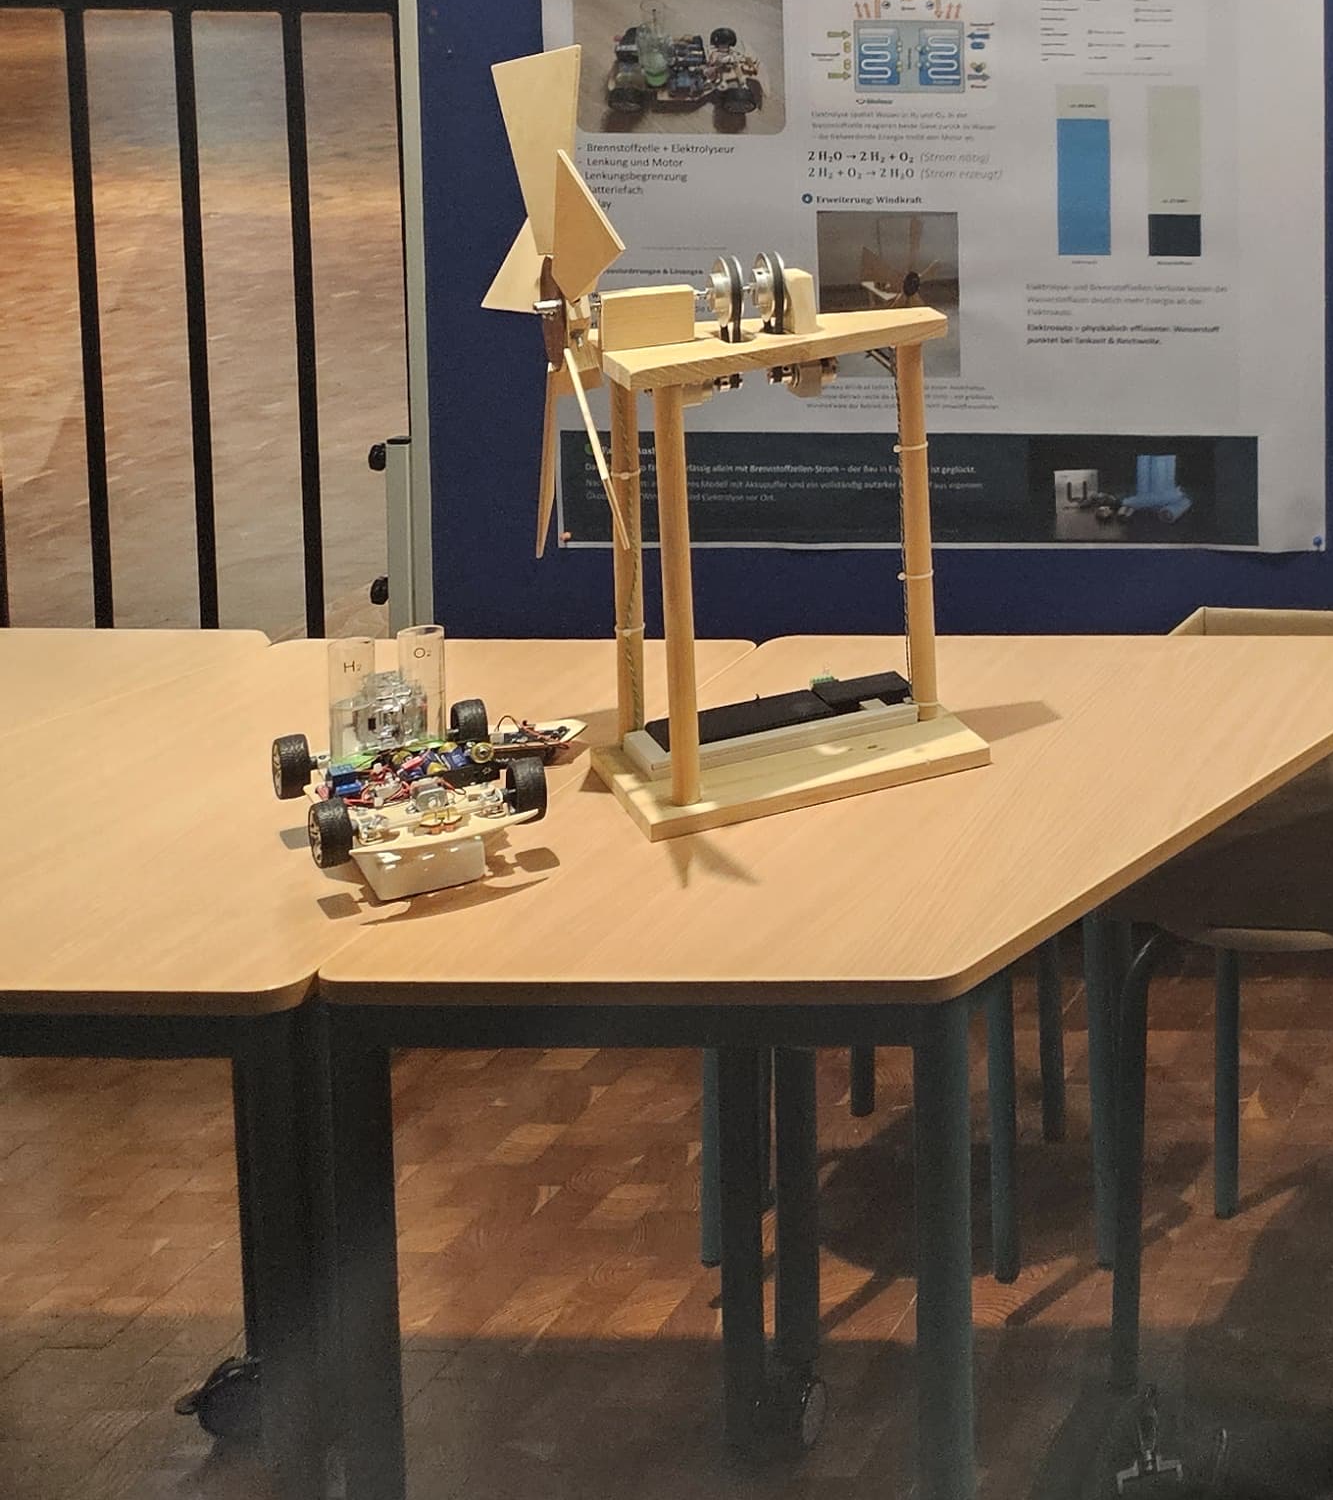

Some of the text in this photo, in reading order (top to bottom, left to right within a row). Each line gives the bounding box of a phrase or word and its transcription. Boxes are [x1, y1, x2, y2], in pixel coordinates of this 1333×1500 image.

[587, 143, 735, 155] Brennstoffzelle Elektrolyseur
[587, 158, 684, 168] Lenkung und Motor
[585, 172, 688, 182] Lenkungsbegrenzung
[876, 195, 922, 204] Windkraft
